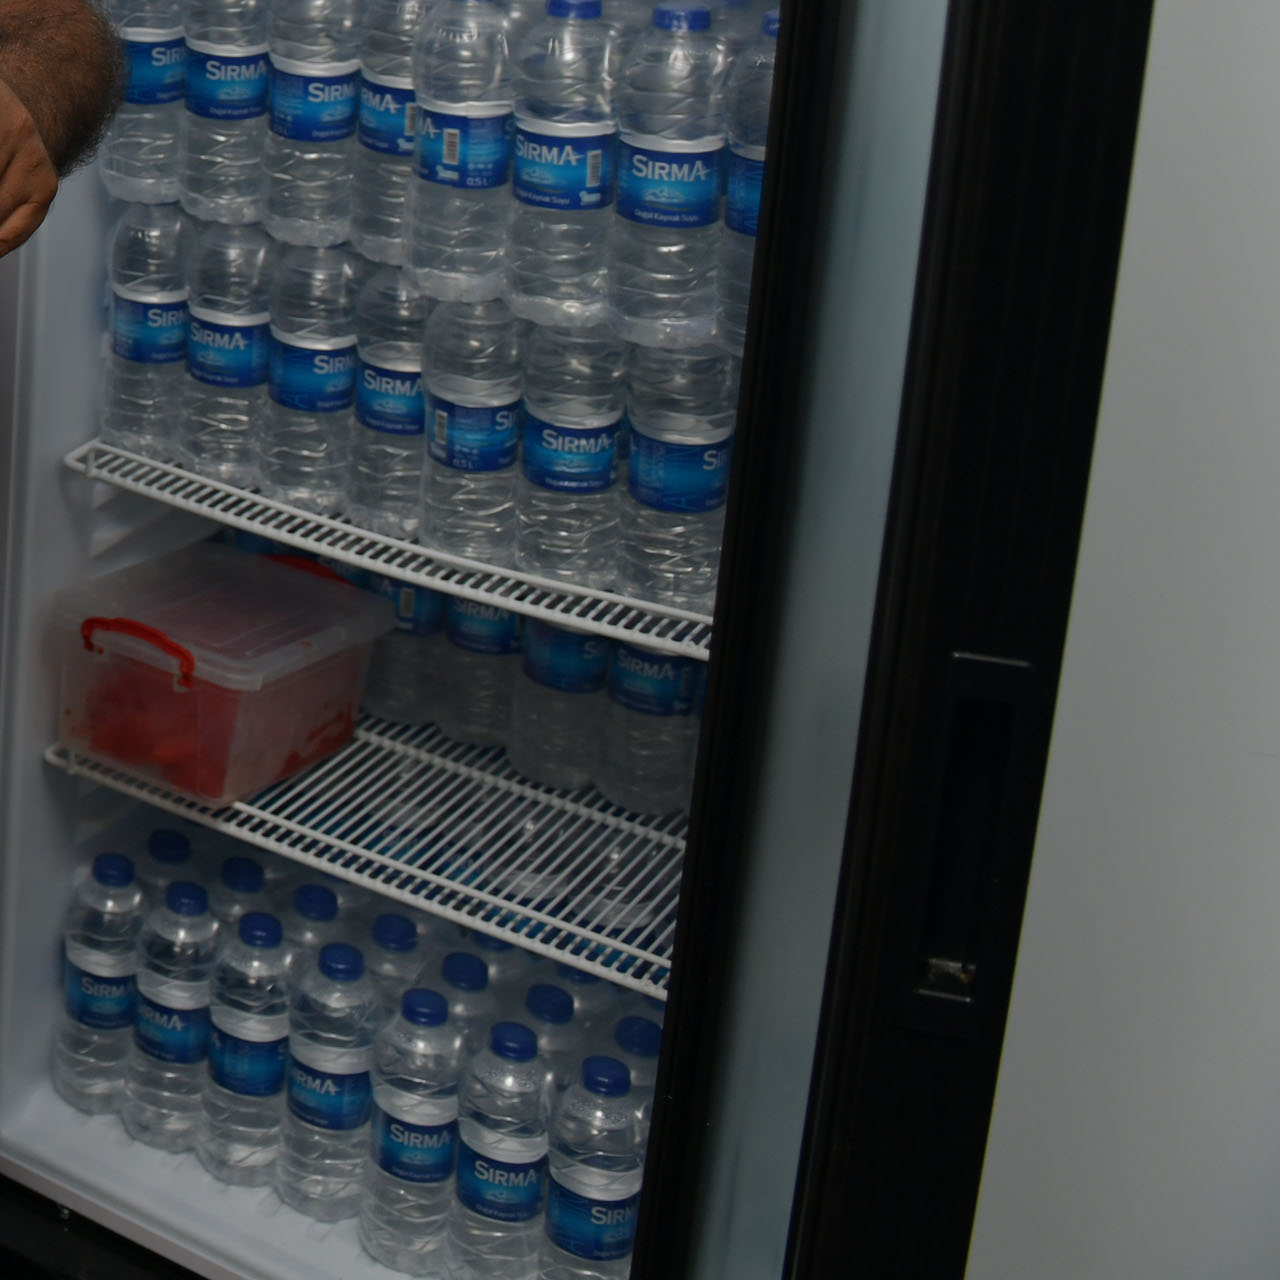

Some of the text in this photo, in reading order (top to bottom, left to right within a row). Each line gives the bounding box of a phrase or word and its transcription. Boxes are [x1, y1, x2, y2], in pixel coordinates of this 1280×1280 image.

[206, 60, 267, 81] SIRMA
[515, 135, 582, 166] SIRMA
[632, 155, 709, 181] SIRMA
[191, 323, 248, 349] SIRMA
[542, 429, 611, 453] SIRMA
[390, 1123, 451, 1149] SIRMA
[474, 1160, 537, 1187] SIRMA
